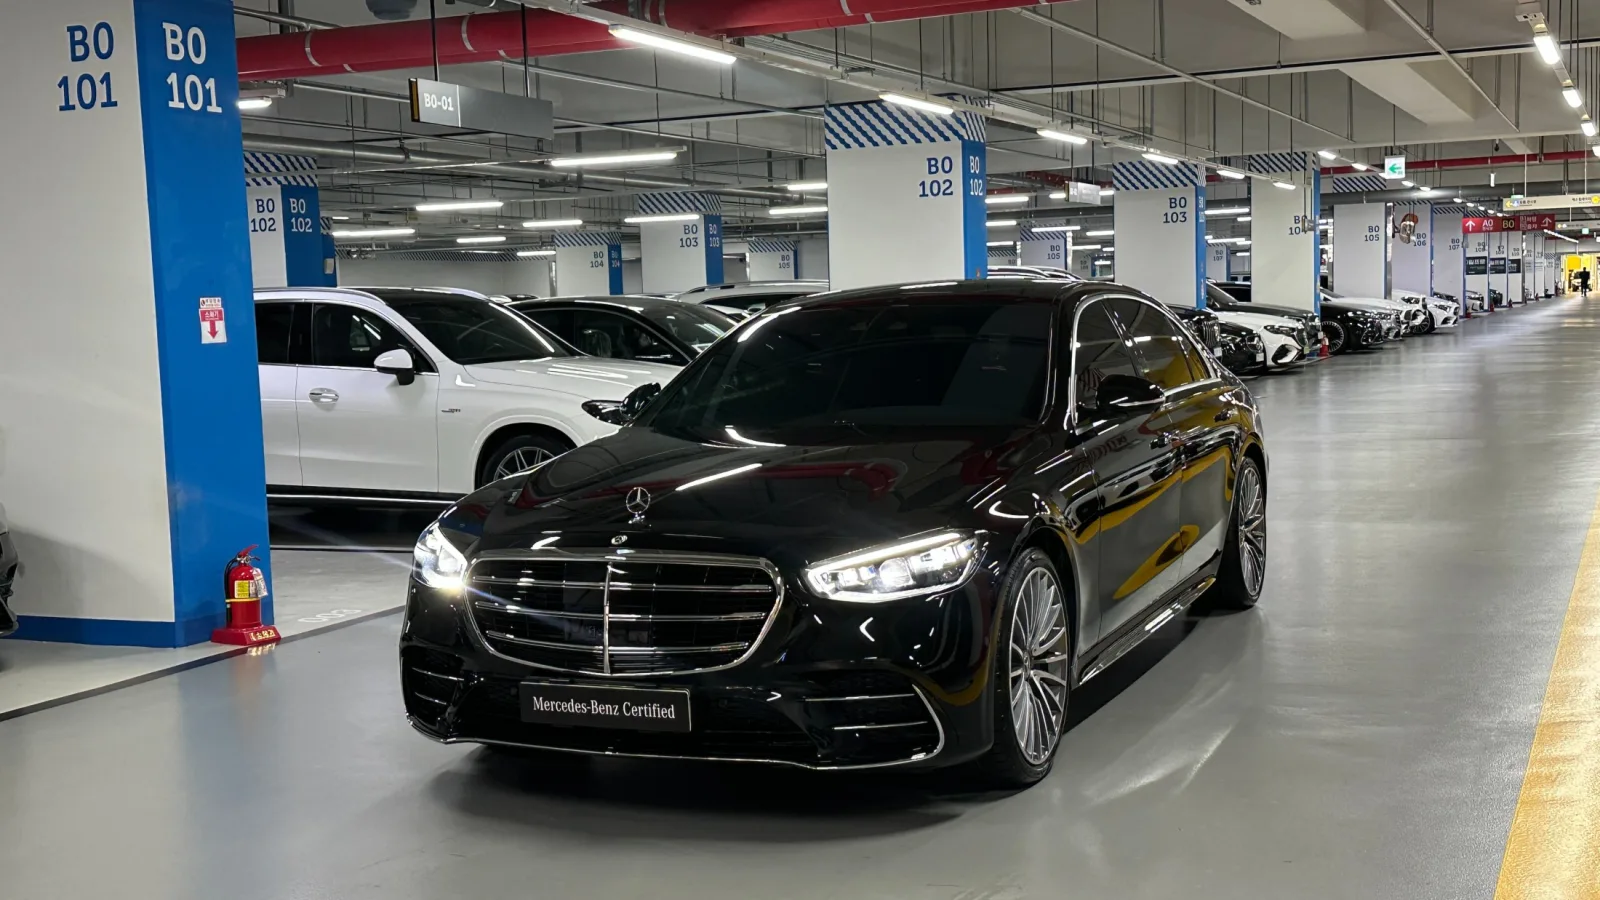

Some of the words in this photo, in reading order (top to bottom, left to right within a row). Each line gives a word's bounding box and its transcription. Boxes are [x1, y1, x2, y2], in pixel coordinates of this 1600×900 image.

[57, 72, 118, 112] 101
[166, 72, 223, 113] 101
[918, 179, 954, 198] 102
[969, 178, 983, 197] 102
[290, 217, 313, 232] 102
[1162, 211, 1188, 224] 103
[250, 218, 277, 232] 102
[679, 237, 699, 248] 103
[709, 237, 720, 248] 103
[1364, 234, 1380, 242] 105
[611, 260, 620, 268] 104
[533, 696, 620, 716] Mercedes-Benz
[622, 702, 676, 719] Certified
